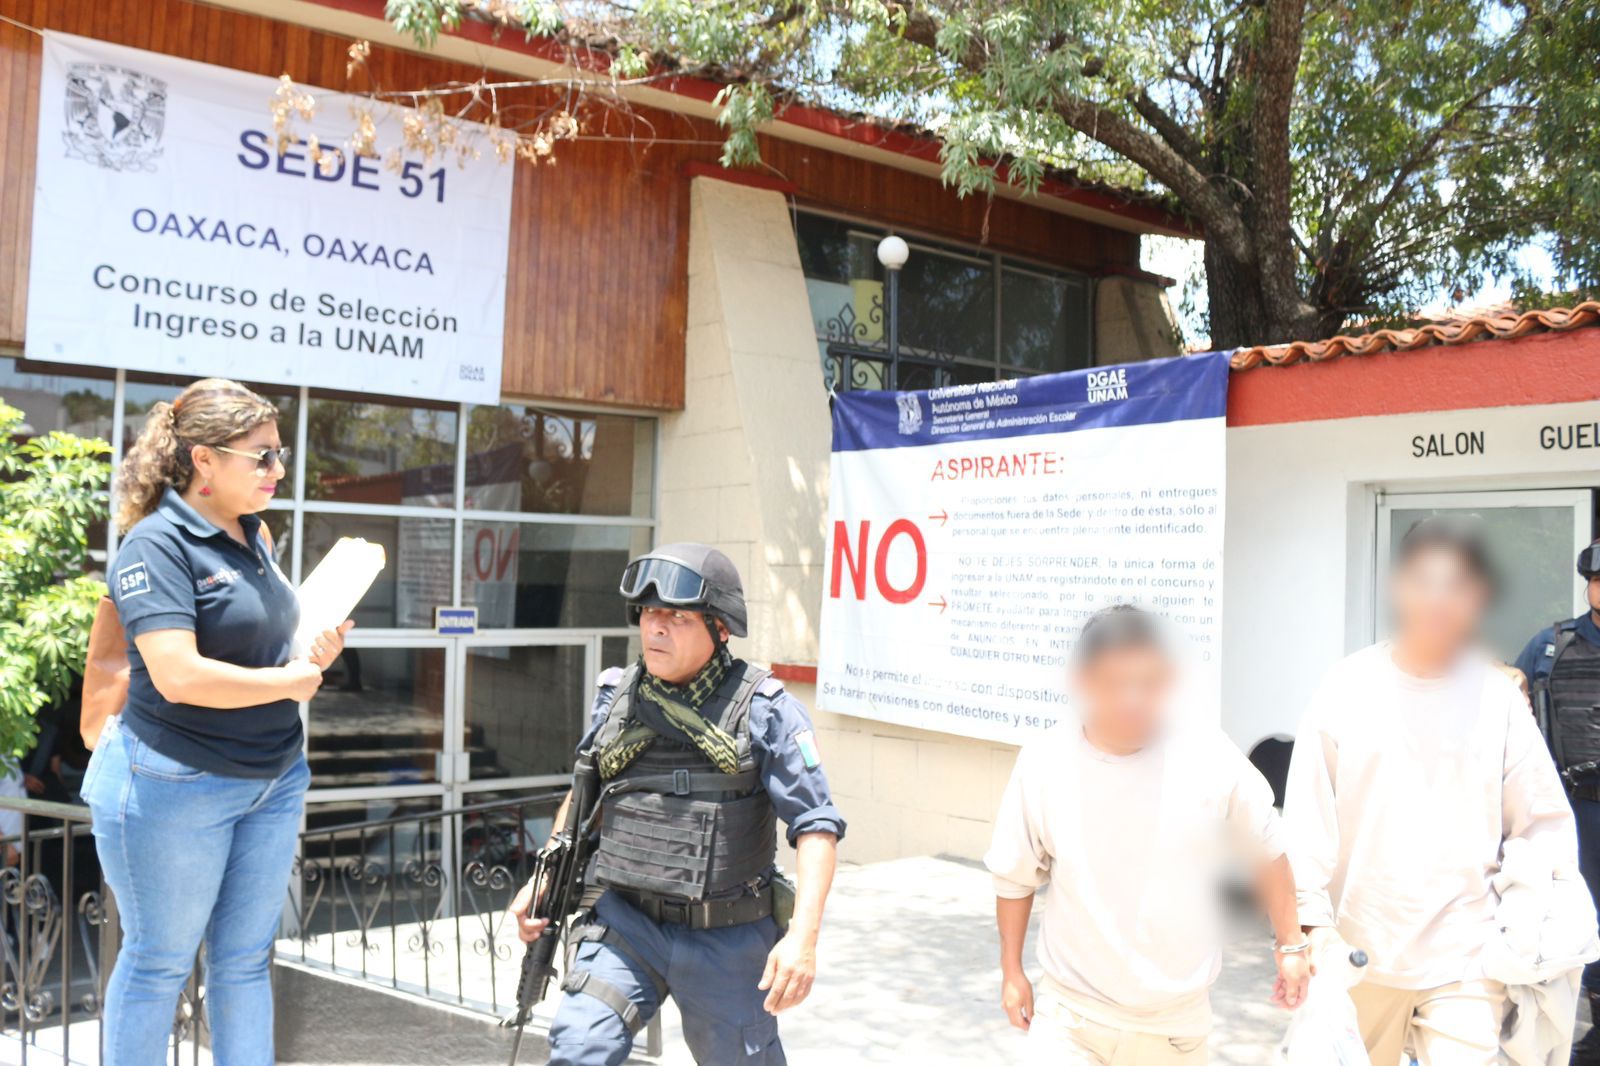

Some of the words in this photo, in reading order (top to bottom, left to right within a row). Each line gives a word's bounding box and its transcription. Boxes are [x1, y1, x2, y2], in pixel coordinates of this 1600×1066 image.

[238, 129, 381, 191] SEDE
[399, 160, 446, 203] 51
[132, 208, 289, 258] OAXACA,
[303, 233, 434, 276] OAXACA
[93, 264, 258, 307] Concurso
[270, 287, 305, 312] de
[317, 292, 457, 333] Selección
[134, 303, 258, 339] Ingreso
[270, 325, 286, 344] a
[299, 323, 322, 348] la
[335, 327, 423, 360] UNAM
[1087, 368, 1126, 388] DGAE
[973, 399, 985, 409] de
[985, 393, 1018, 408] México
[1088, 387, 1129, 403] UNAM
[987, 420, 995, 429] de
[996, 414, 1048, 428] Administración
[1049, 411, 1077, 423] Escolar
[1412, 431, 1485, 458] SALON
[931, 451, 1065, 482] ASPIRANTE:
[1043, 492, 1069, 502] datos
[1141, 487, 1152, 498] ni
[1159, 487, 1218, 501] entregues
[953, 511, 1004, 521] documentos
[1007, 510, 1030, 519] fuera
[1033, 509, 1044, 519] de
[1046, 508, 1054, 518] la
[1131, 505, 1145, 517] de
[1208, 503, 1217, 516] al
[952, 525, 989, 538] personal
[991, 527, 1008, 538] que
[1010, 528, 1021, 536] se
[830, 518, 927, 604] NO
[958, 556, 972, 567] NO
[976, 556, 988, 567] TE
[992, 556, 1023, 568] DEJES
[1108, 557, 1118, 568] la
[1161, 557, 1196, 569] forma
[1202, 557, 1215, 569] de
[121, 571, 145, 591] SSP
[951, 573, 985, 584] ingresar
[995, 573, 1002, 582] la
[1005, 573, 1033, 583] UNAM
[1036, 575, 1047, 584] es
[1120, 576, 1133, 586] en
[1137, 575, 1147, 586] el
[1151, 577, 1205, 588] concurso
[1208, 579, 1215, 591] y
[951, 587, 982, 597] resultar
[1059, 591, 1076, 603] por
[1084, 591, 1094, 602] lo
[1152, 594, 1196, 608] alguien
[1204, 595, 1214, 607] te
[951, 601, 993, 614] PROMETE
[1039, 605, 1060, 617] para
[1174, 613, 1196, 624] con
[1200, 615, 1213, 625] un
[951, 618, 998, 629] mecanismo
[1000, 620, 1040, 631] diferente
[1043, 622, 1051, 634] al
[950, 646, 1000, 661] CUALQUIER
[1002, 652, 1030, 664] OTRO
[1032, 654, 1066, 667] MEDIO
[872, 669, 909, 683] permite
[912, 673, 922, 686] el
[970, 682, 993, 696] con
[997, 683, 1071, 705] dispositivo
[823, 682, 837, 695] Se
[868, 690, 920, 710] revisiones
[922, 700, 943, 713] con
[946, 701, 1009, 723] detectores
[1013, 713, 1021, 728] y
[1025, 715, 1040, 728] se
